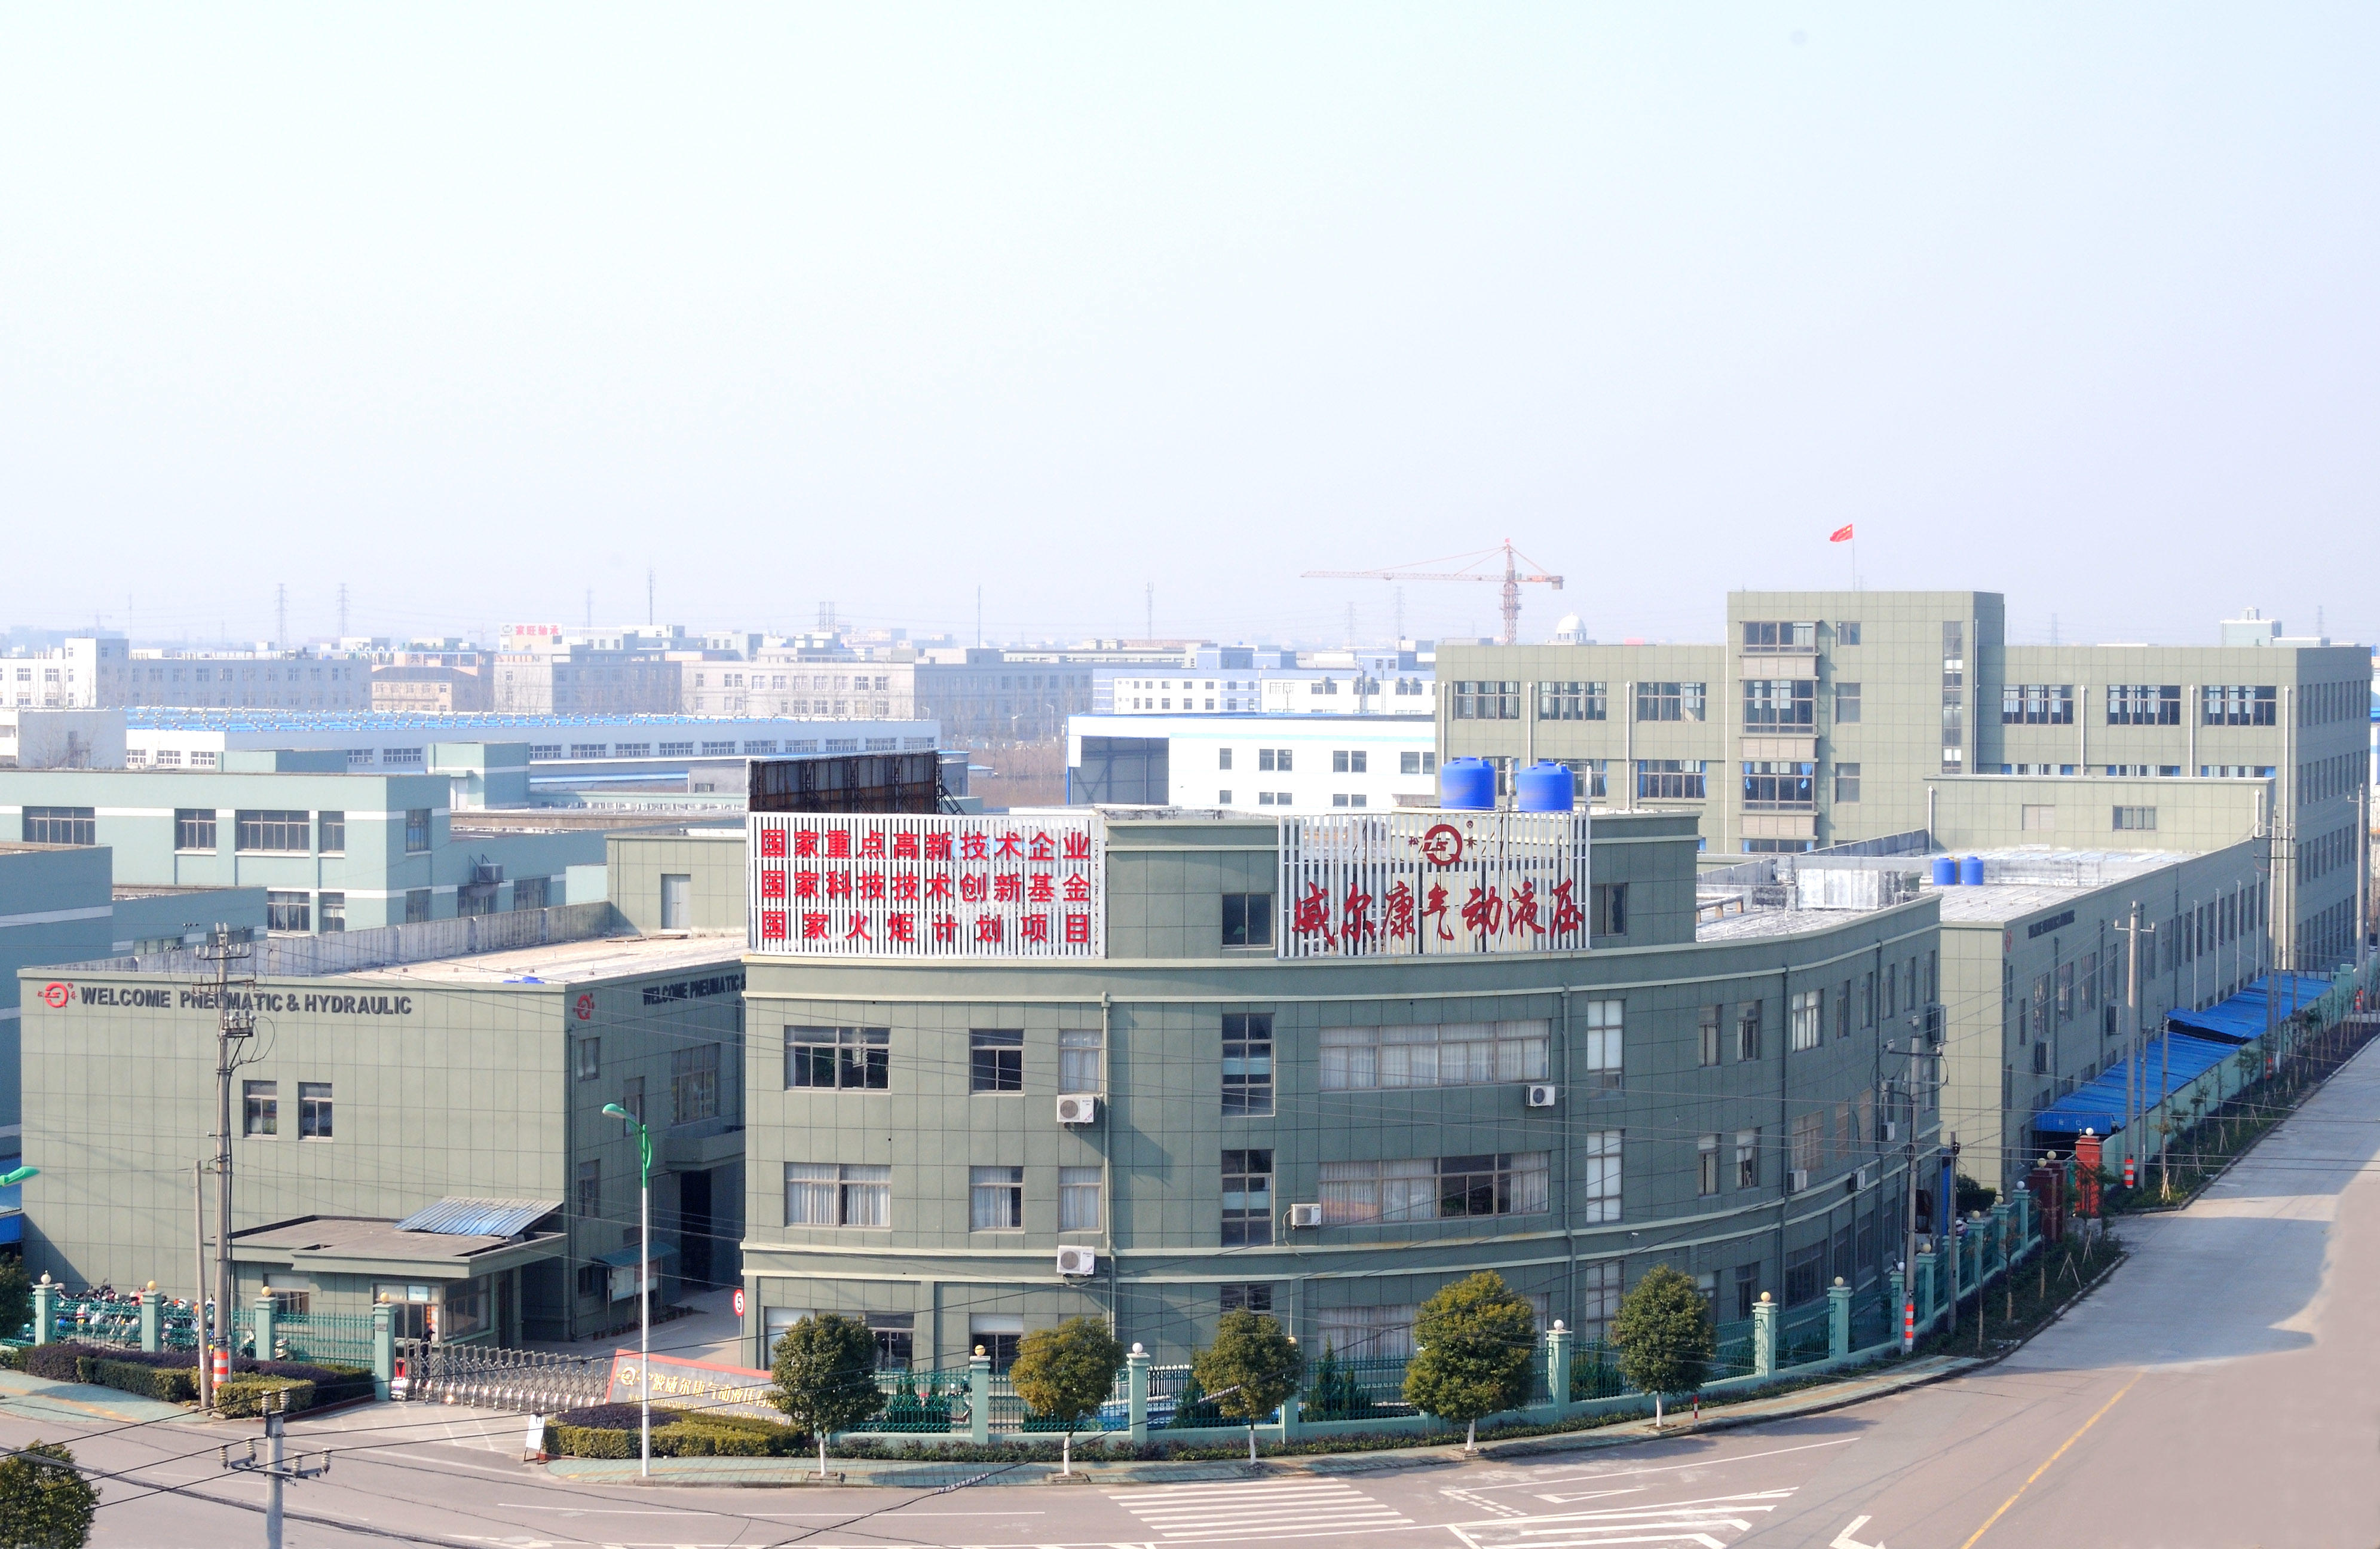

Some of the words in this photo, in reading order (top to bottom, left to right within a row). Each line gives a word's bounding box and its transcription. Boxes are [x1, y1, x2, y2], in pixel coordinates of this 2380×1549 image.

[761, 828, 1091, 861] 国家重点高新技术企业
[761, 868, 1091, 902] 国家科技技术创新基金
[762, 909, 1089, 944] 国家火炬计划项目
[1292, 878, 1584, 947] 威尔康气动液压
[81, 987, 171, 1008] WELCOME
[286, 993, 300, 1012] &
[305, 994, 412, 1015] HYDRAULIC
[642, 981, 688, 1005] WELCOME
[690, 974, 740, 999] PNEUMATIC
[737, 1296, 742, 1311] 5
[648, 1372, 779, 1410] 波威尔康气动液压有
